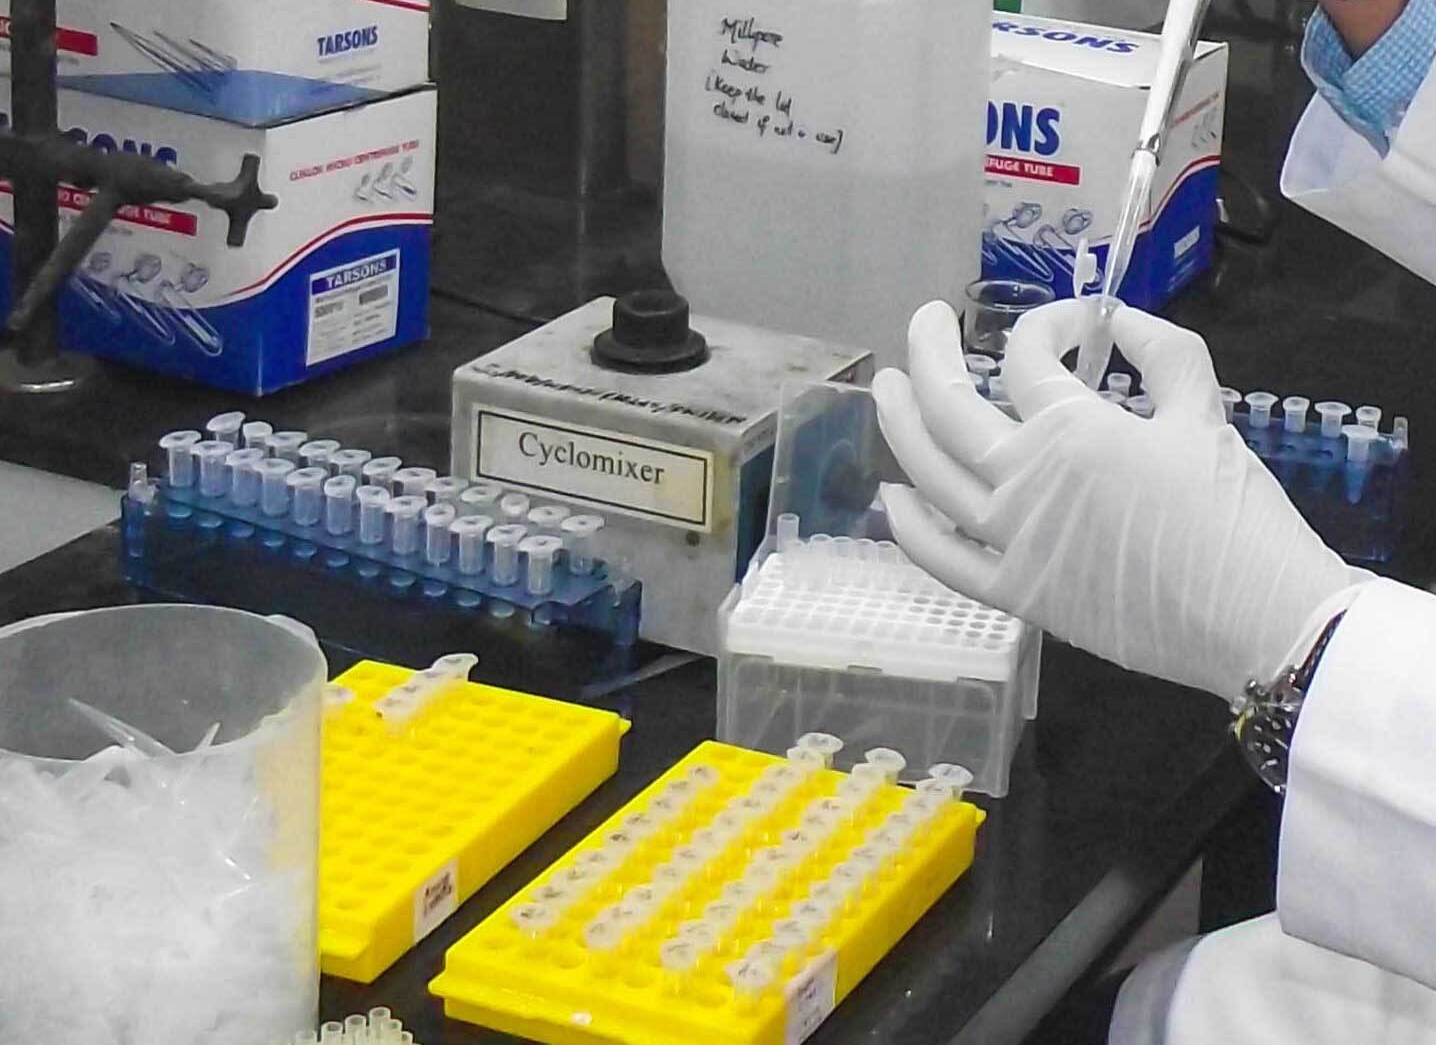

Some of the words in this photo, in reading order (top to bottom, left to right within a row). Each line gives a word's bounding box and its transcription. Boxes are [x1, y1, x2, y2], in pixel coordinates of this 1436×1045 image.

[317, 24, 379, 56] TARSONS
[1024, 163, 1055, 177] TUBE
[326, 258, 387, 289] TARSONS
[518, 432, 666, 484] Cyclomixer
